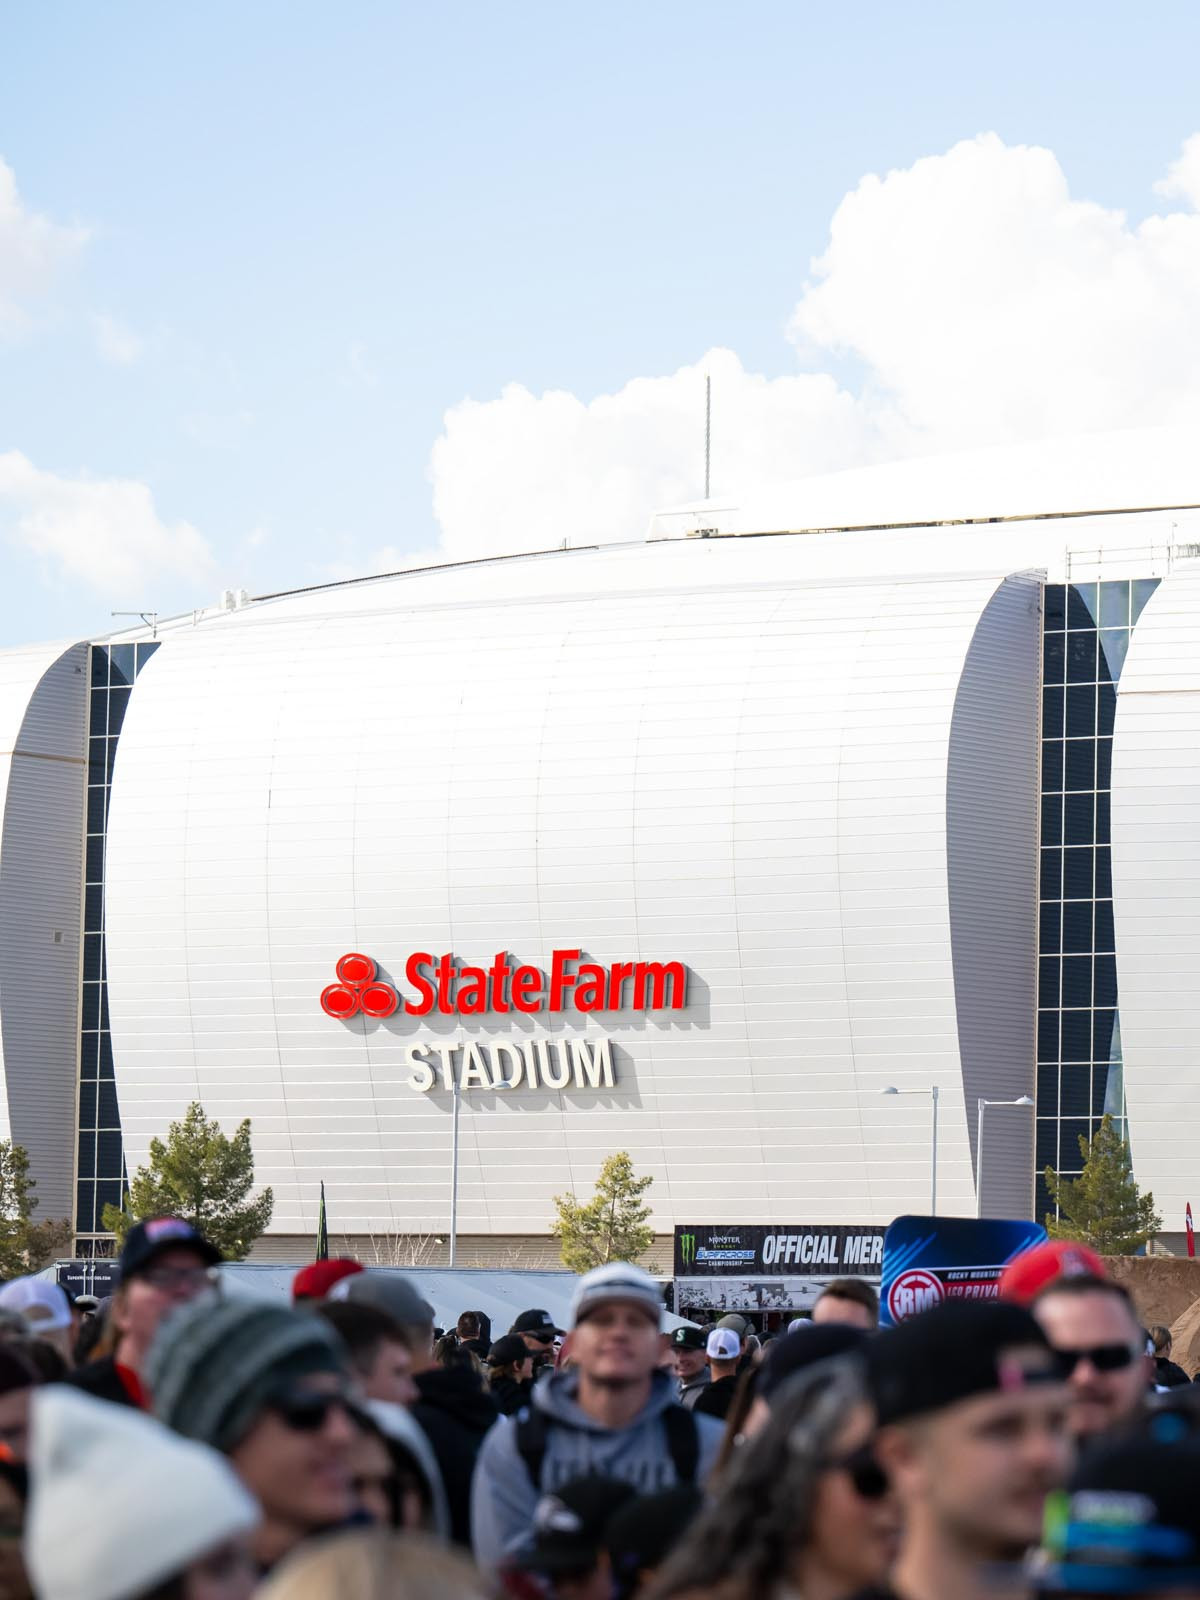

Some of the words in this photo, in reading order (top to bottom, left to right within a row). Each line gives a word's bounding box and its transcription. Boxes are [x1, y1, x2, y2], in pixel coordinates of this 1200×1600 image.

[405, 1038, 616, 1092] STADIUM
[708, 1235, 741, 1245] MONSTER
[762, 1235, 839, 1265] OFFICIAL
[843, 1236, 884, 1265] MER
[947, 1271, 969, 1280] ROCKY
